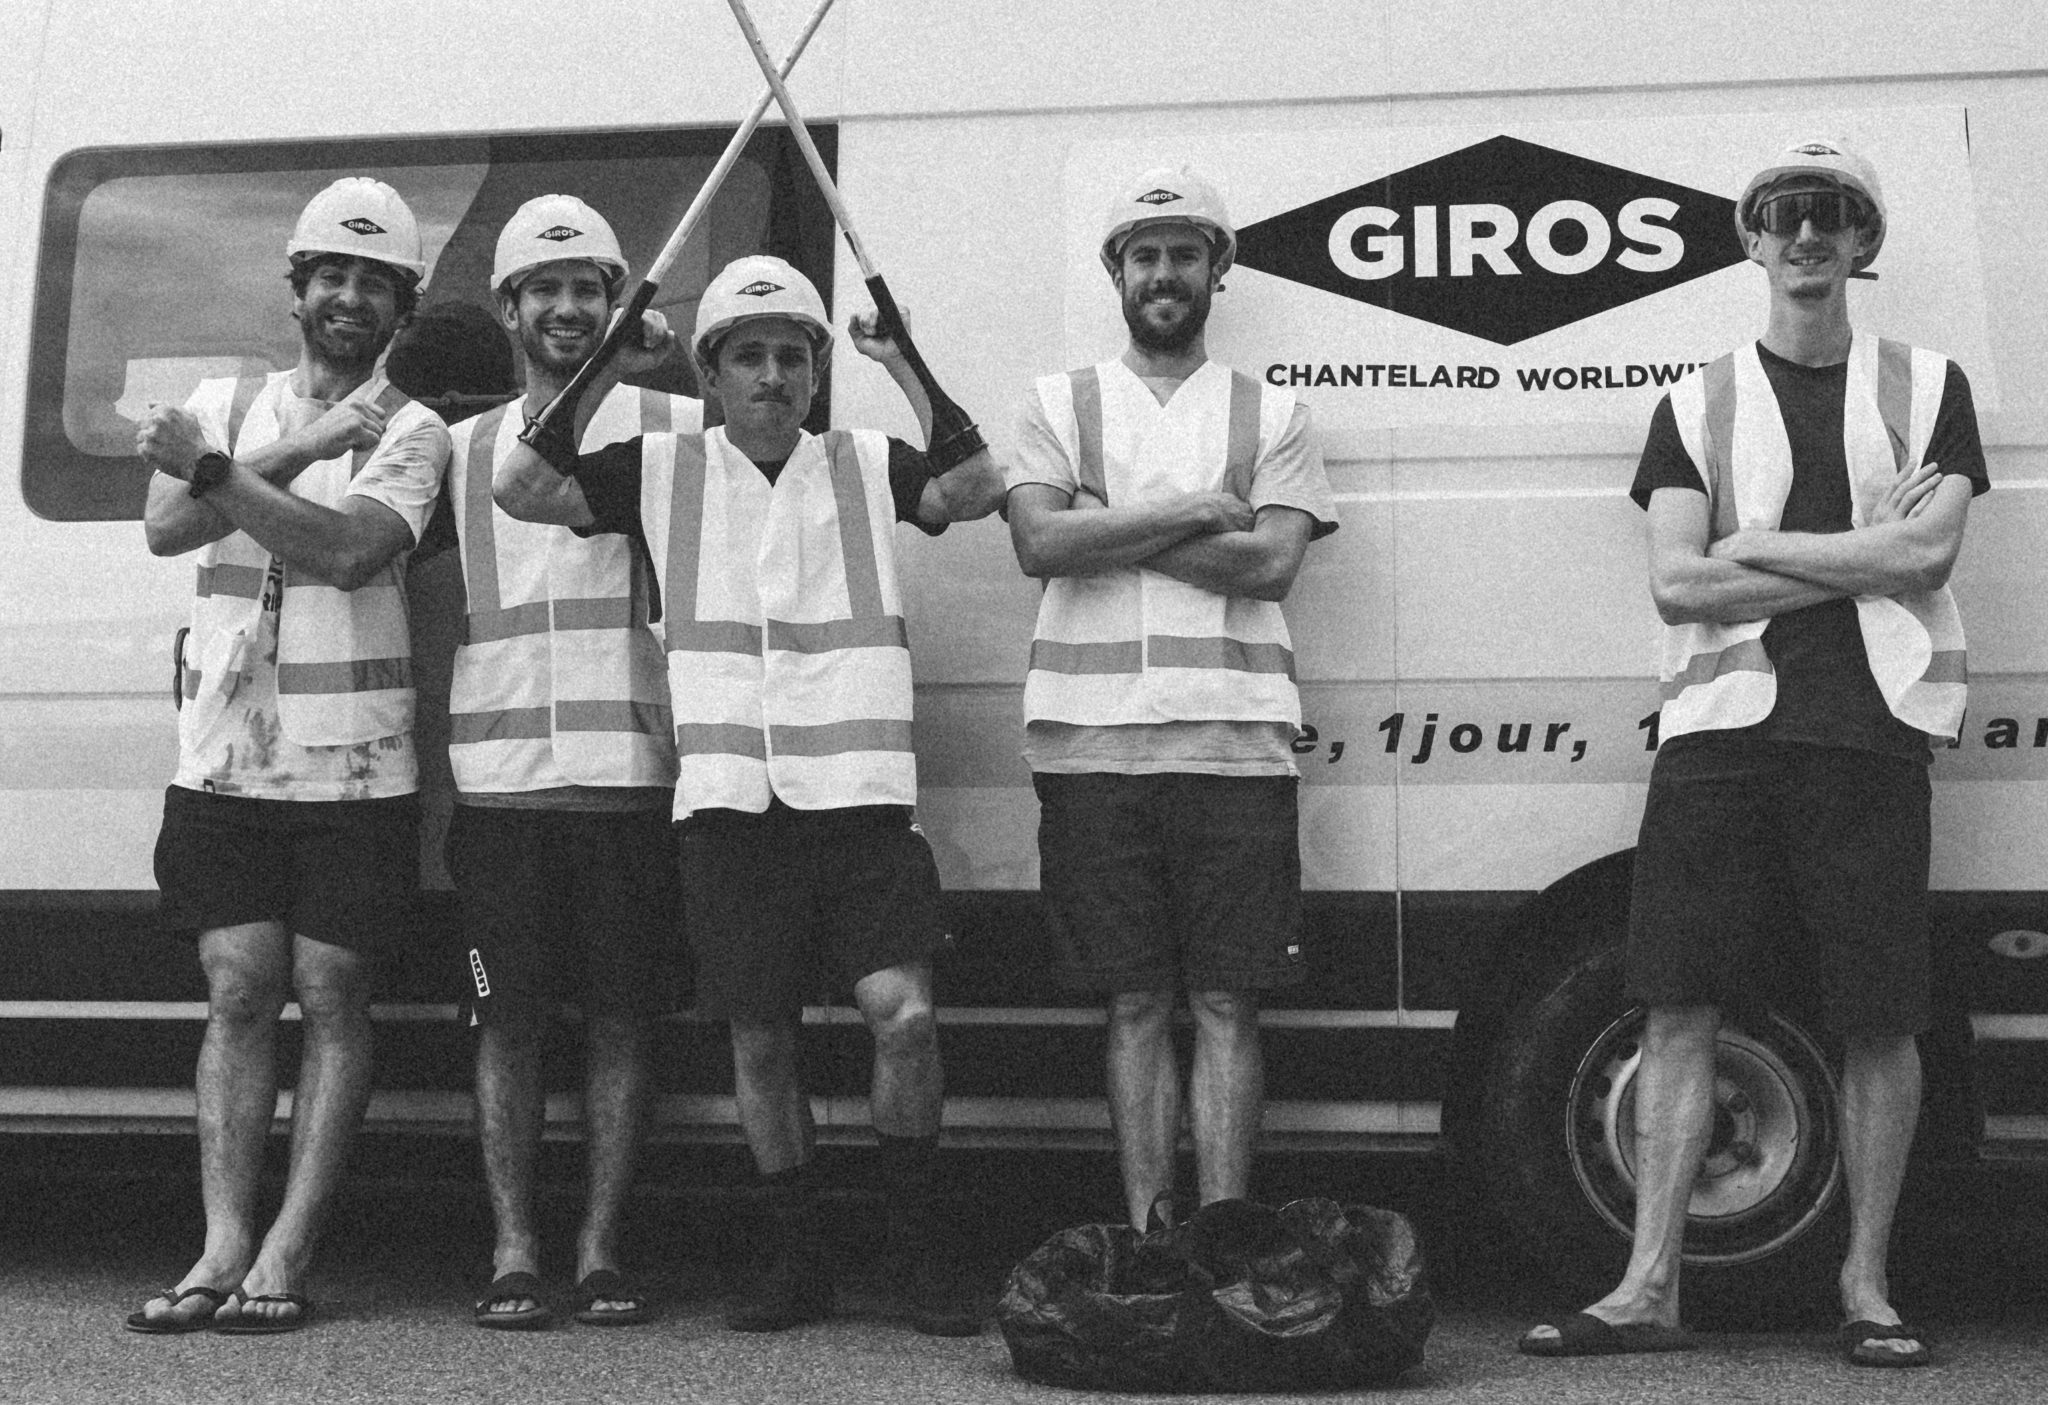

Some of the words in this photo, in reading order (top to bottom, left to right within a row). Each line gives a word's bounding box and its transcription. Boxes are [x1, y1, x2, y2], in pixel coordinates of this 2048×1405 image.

[1143, 193, 1174, 202] GIROS
[347, 221, 377, 232] GIROS
[544, 229, 575, 238] GIROS
[1328, 197, 1685, 281] GIROS
[745, 284, 775, 294] GIROS
[1266, 363, 1500, 389] CHANTELARD
[1516, 362, 1708, 392] WORLDW
